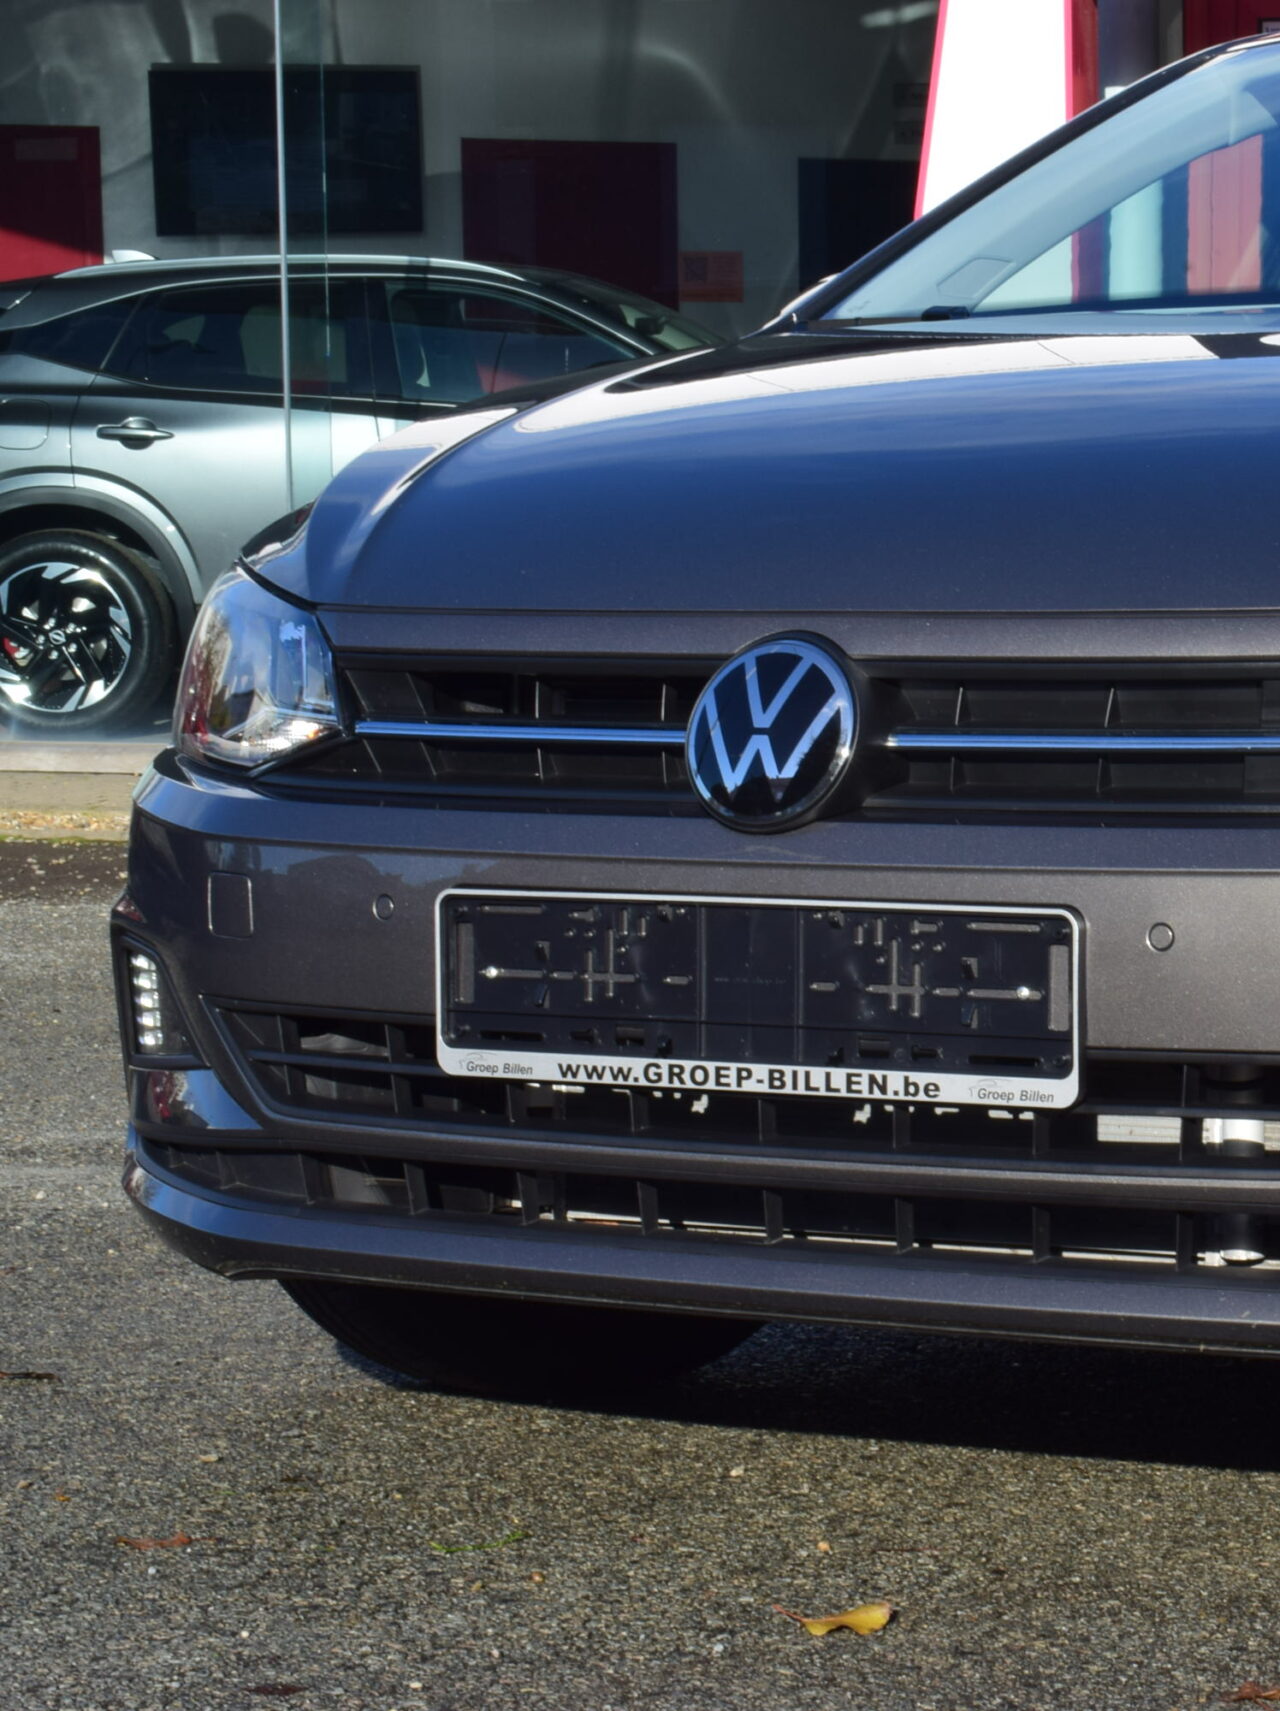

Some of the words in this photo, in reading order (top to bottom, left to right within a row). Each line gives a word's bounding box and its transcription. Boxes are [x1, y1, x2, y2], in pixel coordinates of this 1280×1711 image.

[466, 1060, 499, 1075] Groep
[502, 1062, 534, 1075] Billen
[557, 1061, 941, 1099] www.GROEP-BILLEN.be
[977, 1087, 1015, 1103] Groep
[1019, 1089, 1055, 1103] Billen
